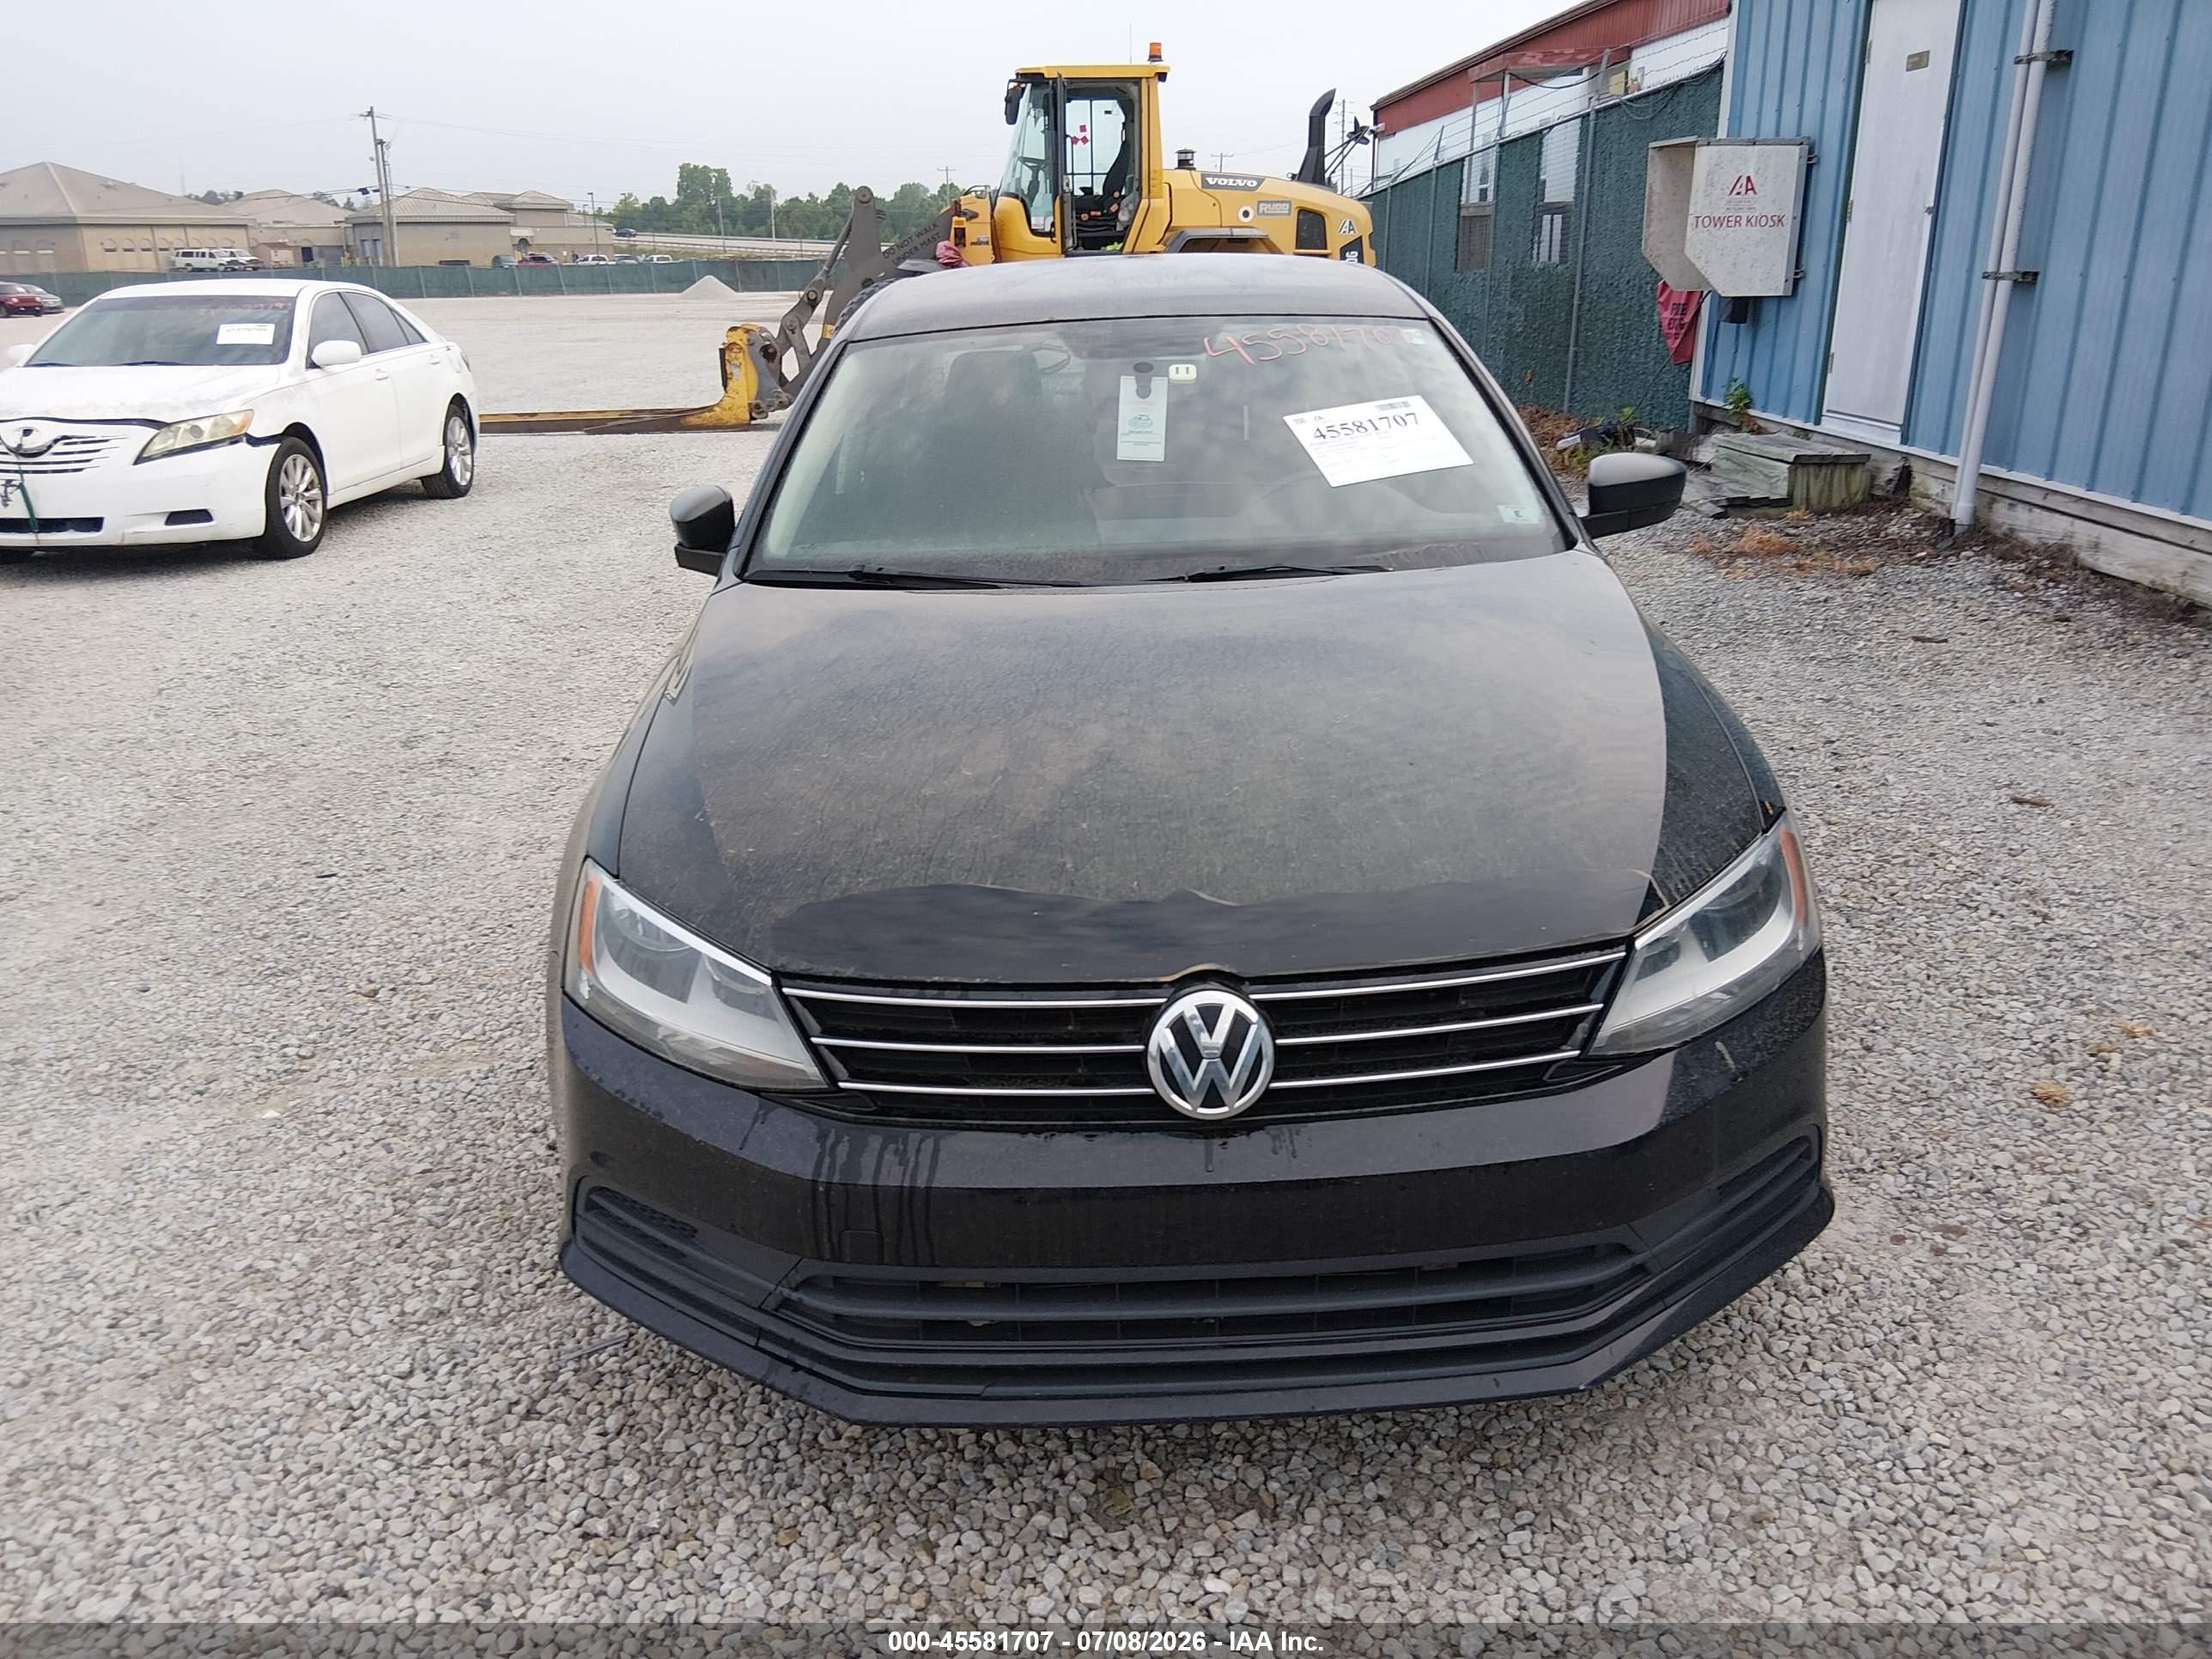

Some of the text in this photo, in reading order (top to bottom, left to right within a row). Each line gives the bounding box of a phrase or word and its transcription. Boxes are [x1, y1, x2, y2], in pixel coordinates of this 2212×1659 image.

[1205, 177, 1257, 187] VOLVO
[1694, 214, 1786, 228] TOWER KIOSK
[882, 222, 940, 259] DO NOT WALK
[920, 231, 941, 247] MAST
[1202, 323, 1415, 366] 45581707
[1313, 412, 1419, 441] 45581707
